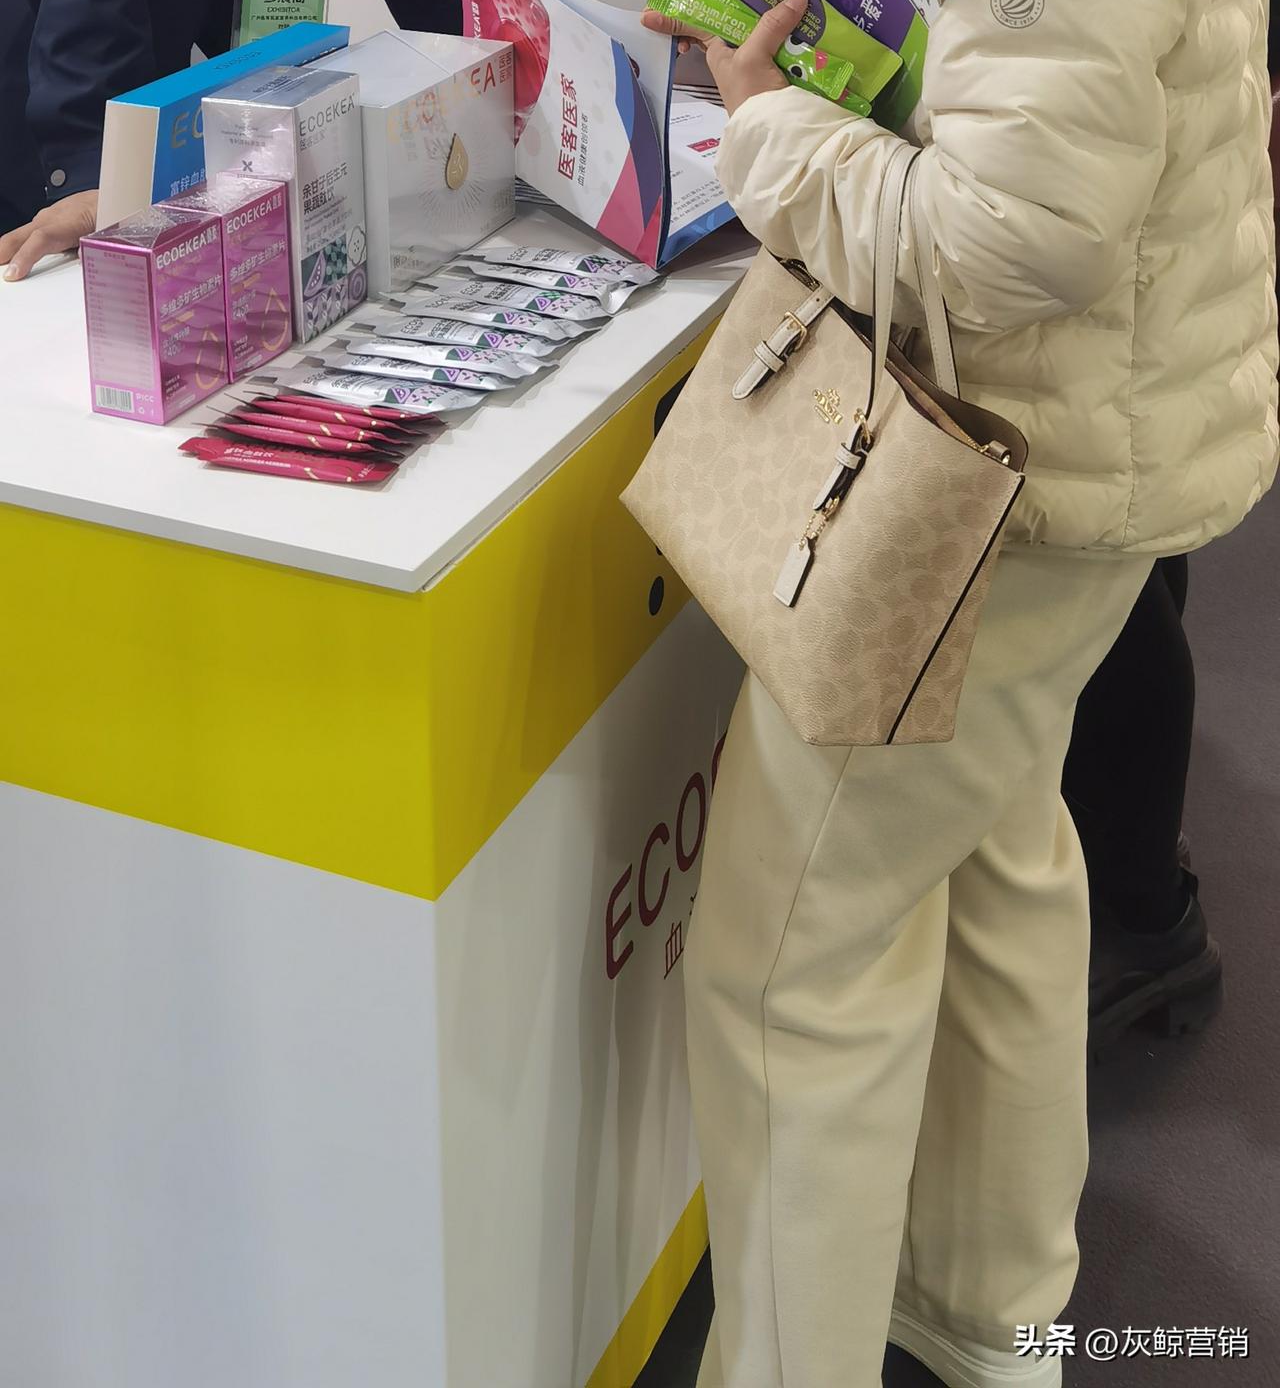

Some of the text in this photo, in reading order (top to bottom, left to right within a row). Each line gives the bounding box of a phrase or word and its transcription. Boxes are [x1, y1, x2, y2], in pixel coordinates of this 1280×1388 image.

[299, 93, 354, 137] ECOEKEA
[558, 73, 577, 180] 医客医家
[226, 199, 272, 235] ECOEKEA
[156, 234, 207, 271] ECOEKEA
